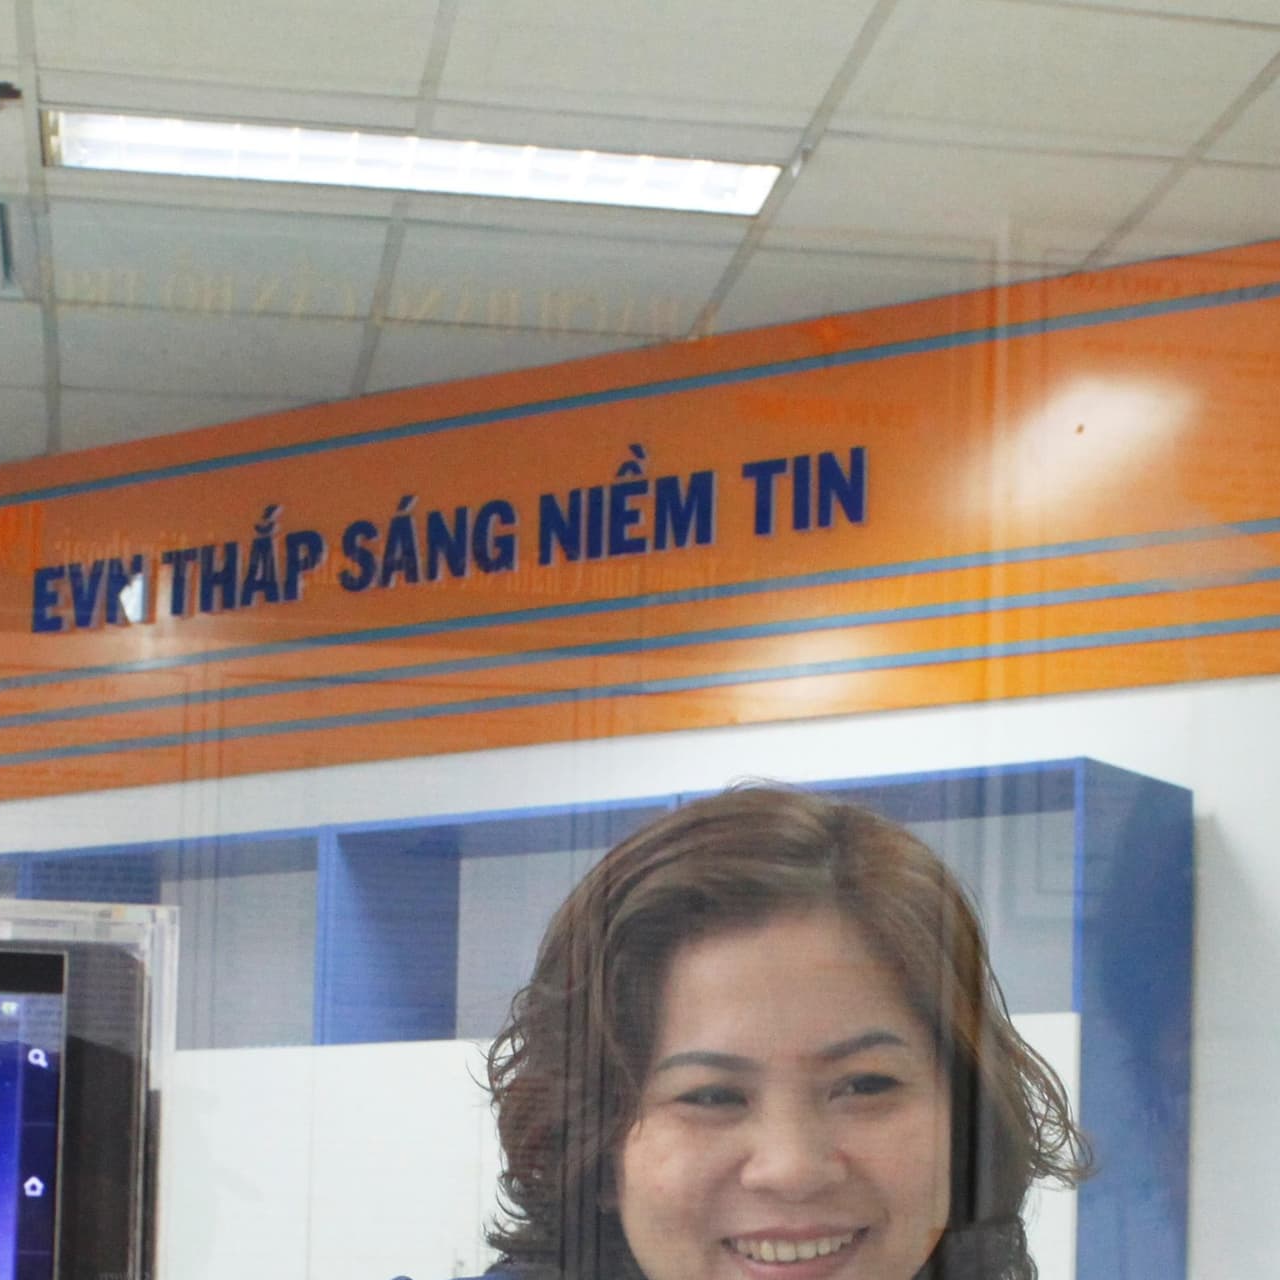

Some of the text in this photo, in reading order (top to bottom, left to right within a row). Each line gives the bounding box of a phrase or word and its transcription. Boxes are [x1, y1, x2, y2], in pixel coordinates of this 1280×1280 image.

[33, 555, 144, 633] EVN
[163, 504, 323, 617] THẮP
[339, 495, 516, 592] SÁNG
[538, 445, 715, 566] NIỀM
[742, 447, 866, 535] TIN
